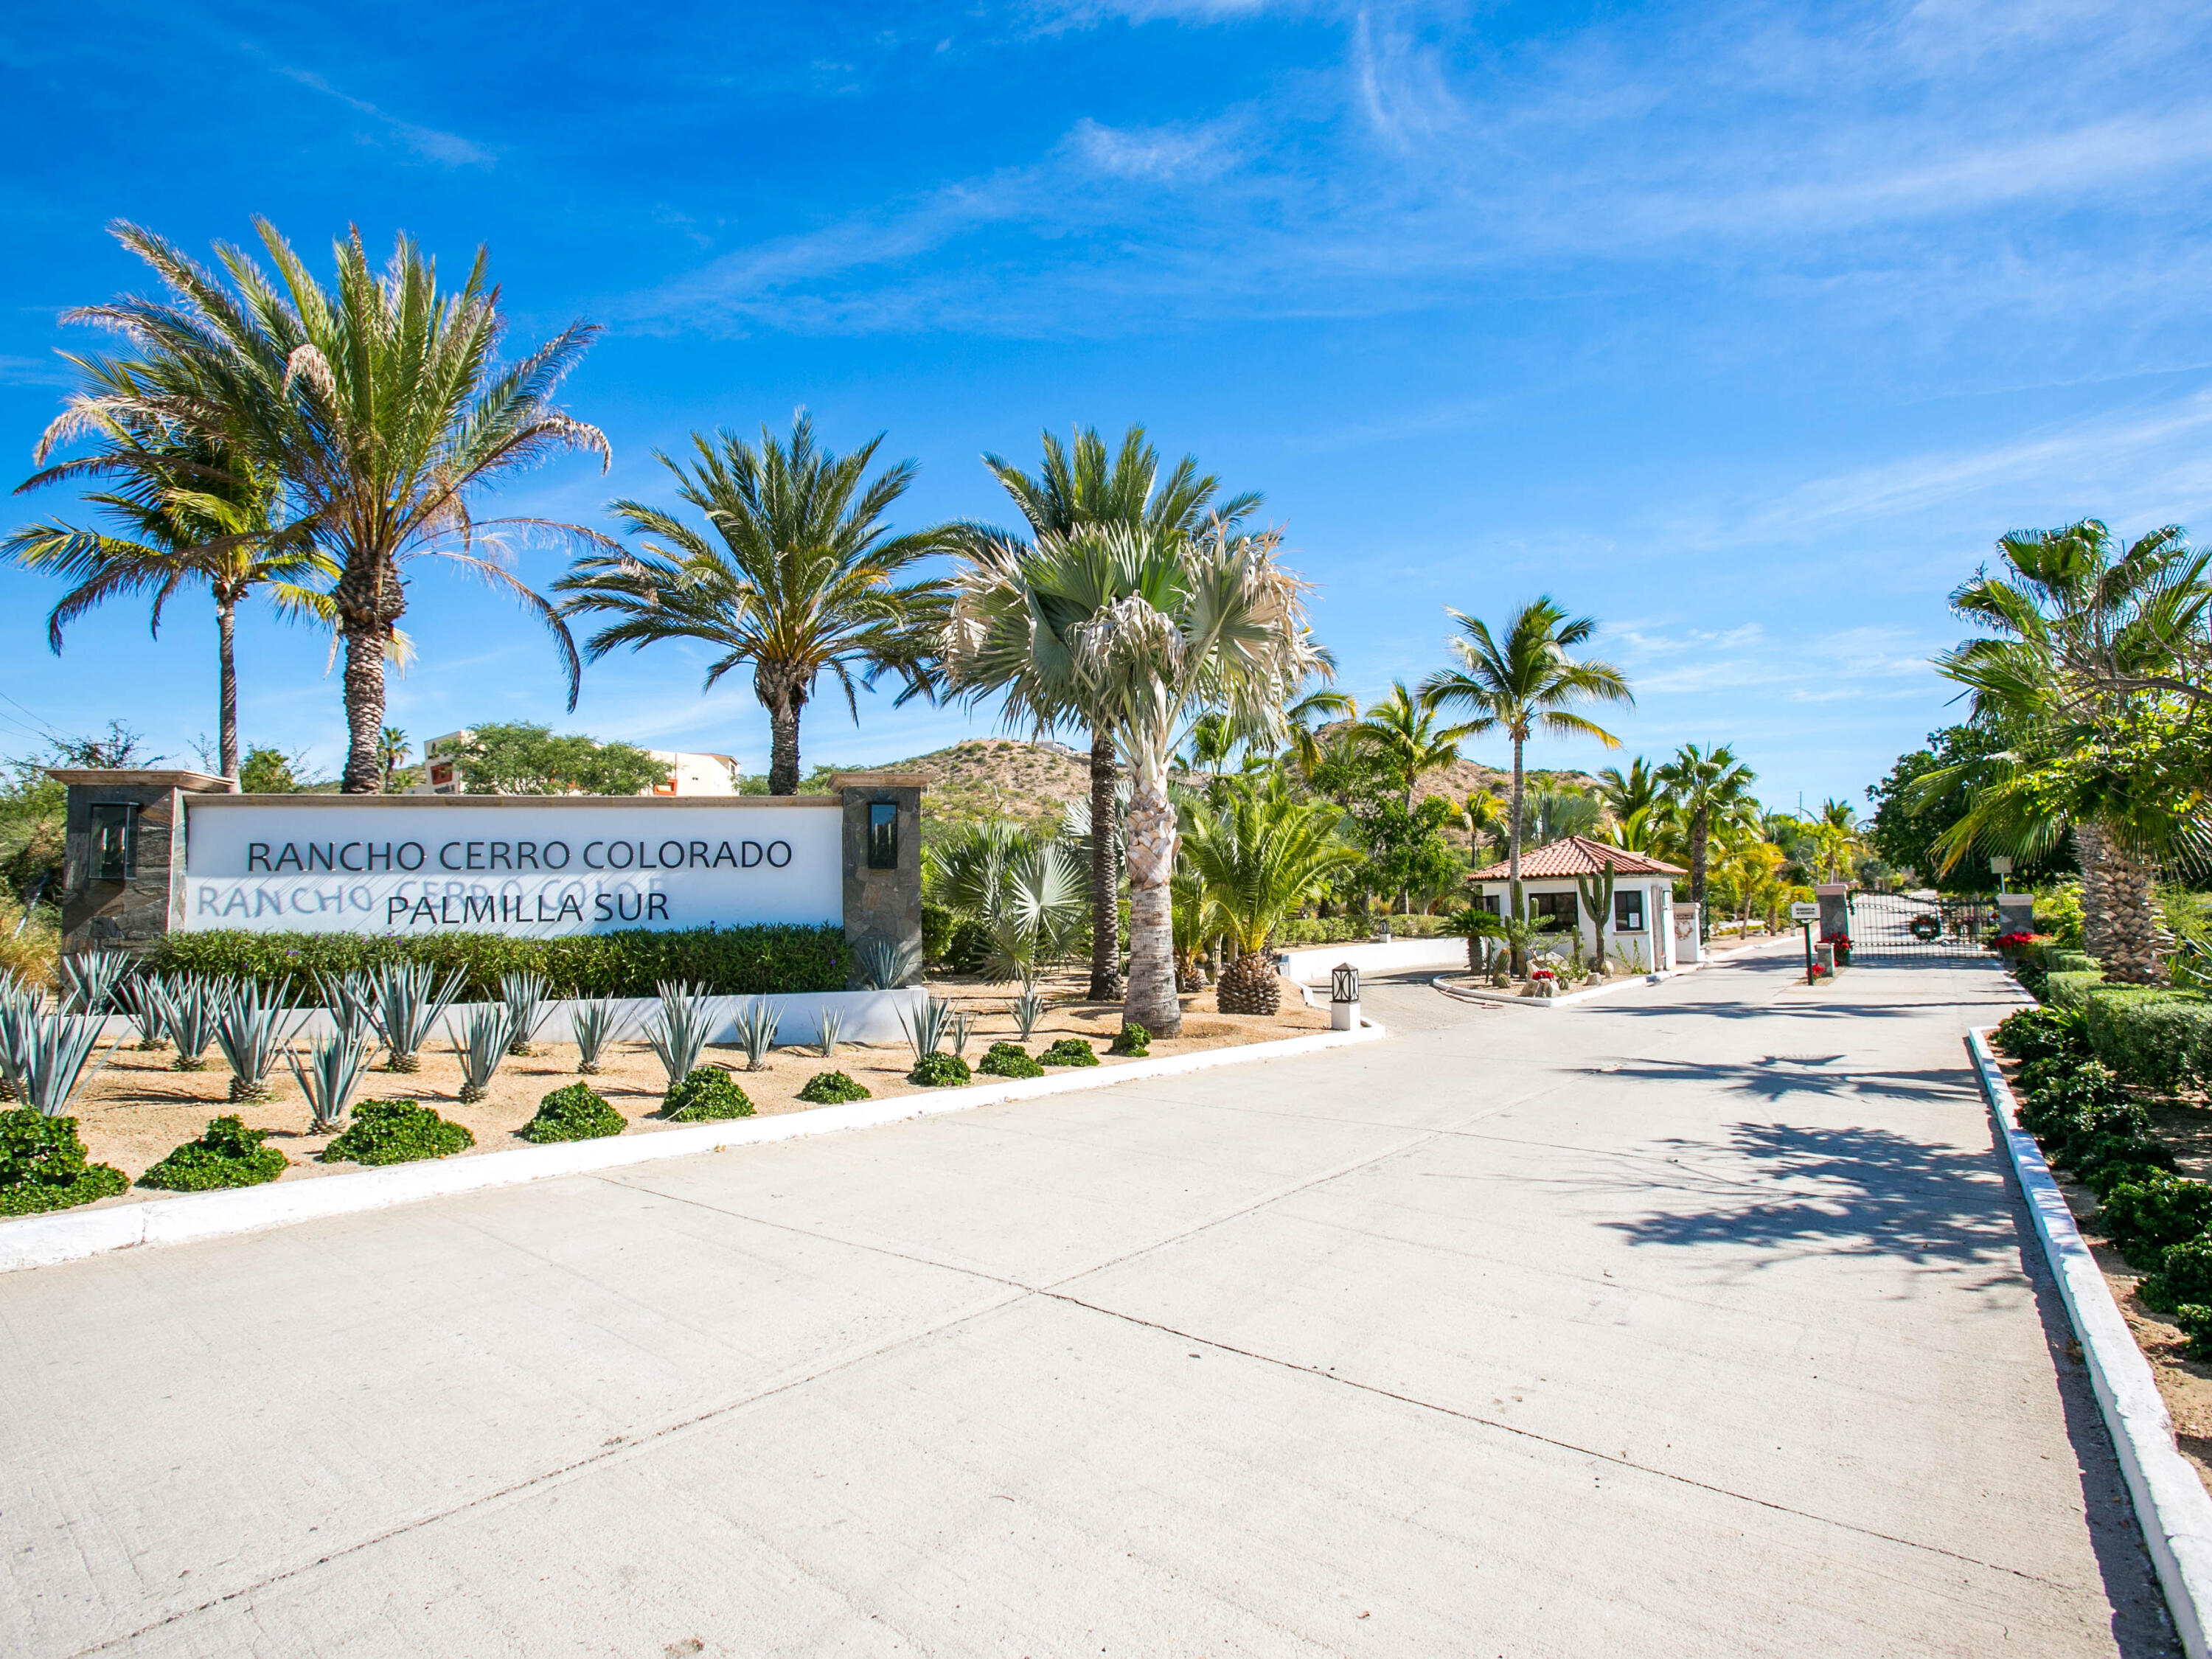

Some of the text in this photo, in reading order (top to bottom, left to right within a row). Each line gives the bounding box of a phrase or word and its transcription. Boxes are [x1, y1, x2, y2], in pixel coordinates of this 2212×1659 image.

[248, 841, 793, 872] RANCHO CERRO COLORADO
[387, 894, 583, 925] PALMILLA
[594, 893, 669, 922] SUR
